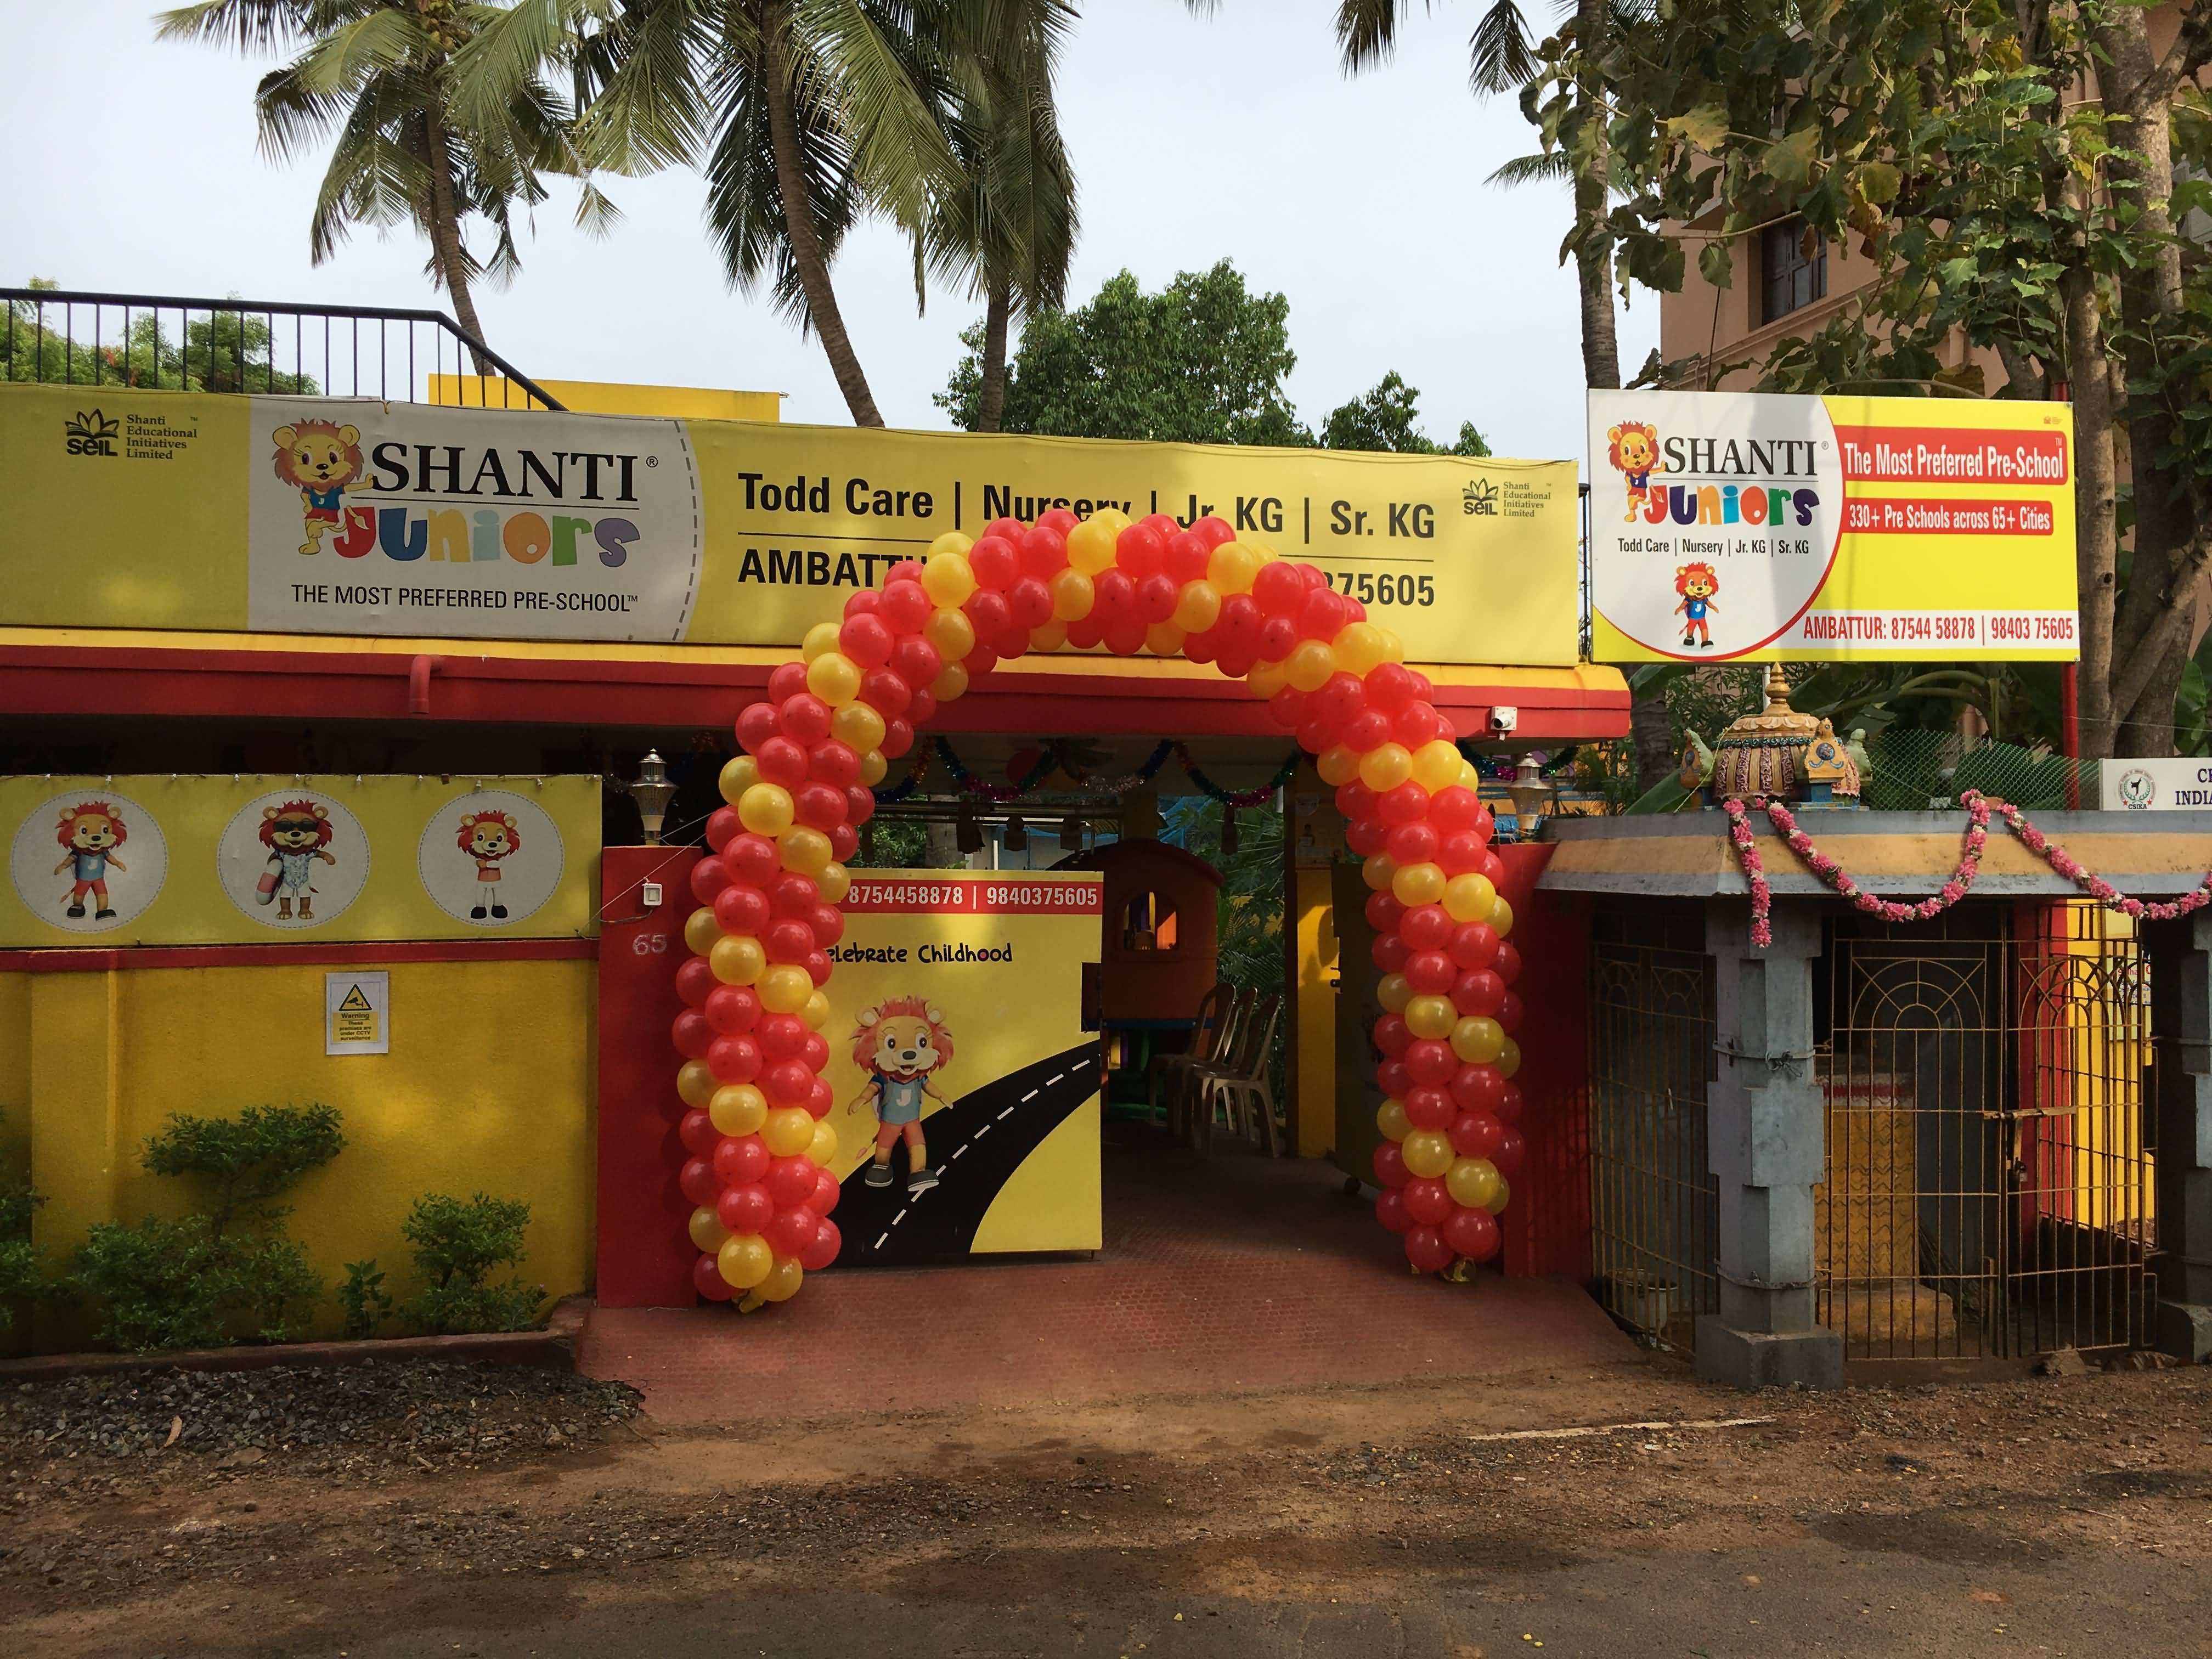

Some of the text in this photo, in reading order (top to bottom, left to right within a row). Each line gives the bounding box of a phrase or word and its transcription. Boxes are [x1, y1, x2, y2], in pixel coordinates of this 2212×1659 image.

[127, 414, 166, 425] Shanti
[127, 426, 198, 438] Educational
[127, 437, 187, 449] Initiatives
[127, 449, 173, 460] Limited
[1664, 437, 1818, 476] SHANTI
[1844, 443, 1872, 475] The
[1876, 443, 1914, 476] Most
[1917, 444, 1983, 477] Preferred
[1987, 446, 2063, 479] Pre-School
[371, 442, 638, 501] SHANTI
[1503, 482, 1530, 490] Shanti
[1503, 491, 1551, 500] Educational
[737, 472, 830, 514] Todd
[845, 478, 933, 518] Care
[1236, 496, 1283, 532] KG
[1330, 500, 1373, 535] Sr.
[1389, 503, 1434, 538] KG
[1503, 500, 1544, 509] Initiatives
[1504, 509, 1535, 517] Limited
[1849, 504, 2050, 531] 330+ Pre Schools across 65+ Cities
[1618, 538, 1809, 556] Todd Care Nursery Jr. KG Sr. KG
[738, 549, 927, 588] AMBATT
[291, 584, 329, 603] THE
[335, 586, 392, 606] MOST
[398, 588, 507, 609] PREFERRED
[1803, 616, 2073, 640] AMBATTUR: 87544 58878 98403 75605
[849, 885, 1097, 906] 8754458878 9840375605
[633, 934, 667, 955] 65
[917, 943, 1012, 963] Childhood
